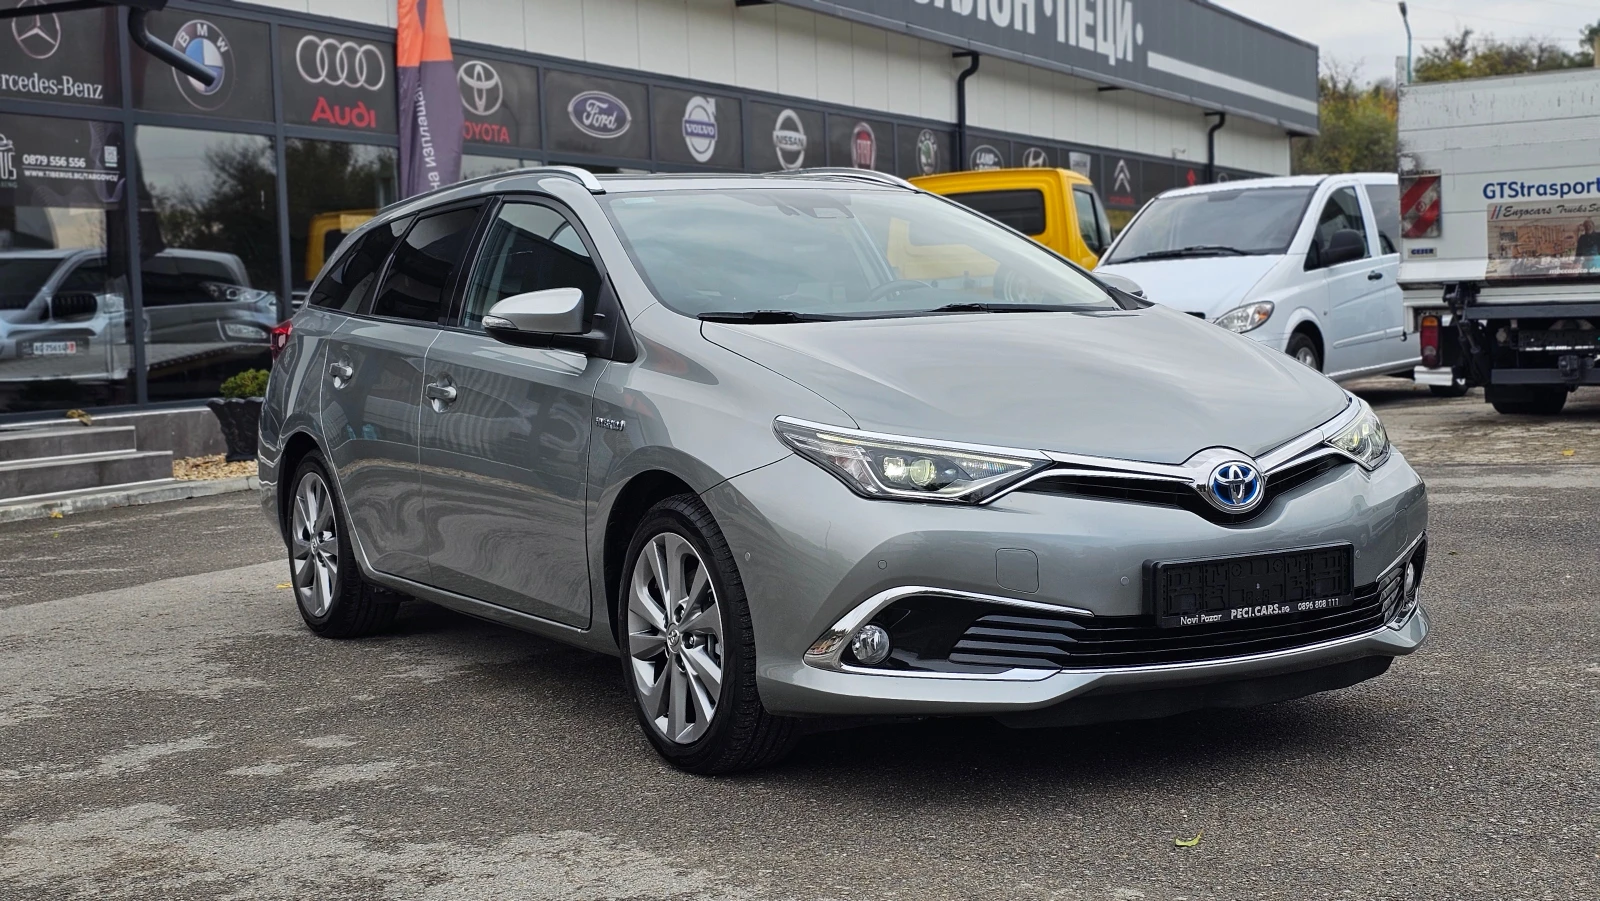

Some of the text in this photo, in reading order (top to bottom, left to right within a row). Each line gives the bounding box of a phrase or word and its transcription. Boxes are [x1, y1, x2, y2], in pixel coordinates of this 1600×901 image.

[177, 22, 229, 54] BMW
[0, 72, 104, 99] rcedes-Benz
[311, 96, 376, 128] Audi
[582, 100, 619, 129] Ford
[462, 121, 510, 143] OYOTA
[685, 123, 715, 136] VOLVO
[776, 134, 804, 147] NISSAN
[22, 154, 86, 168] 0879 556 556
[1180, 615, 1199, 626] Novi
[1200, 614, 1222, 623] Pazar
[1297, 601, 1314, 611] 0896
